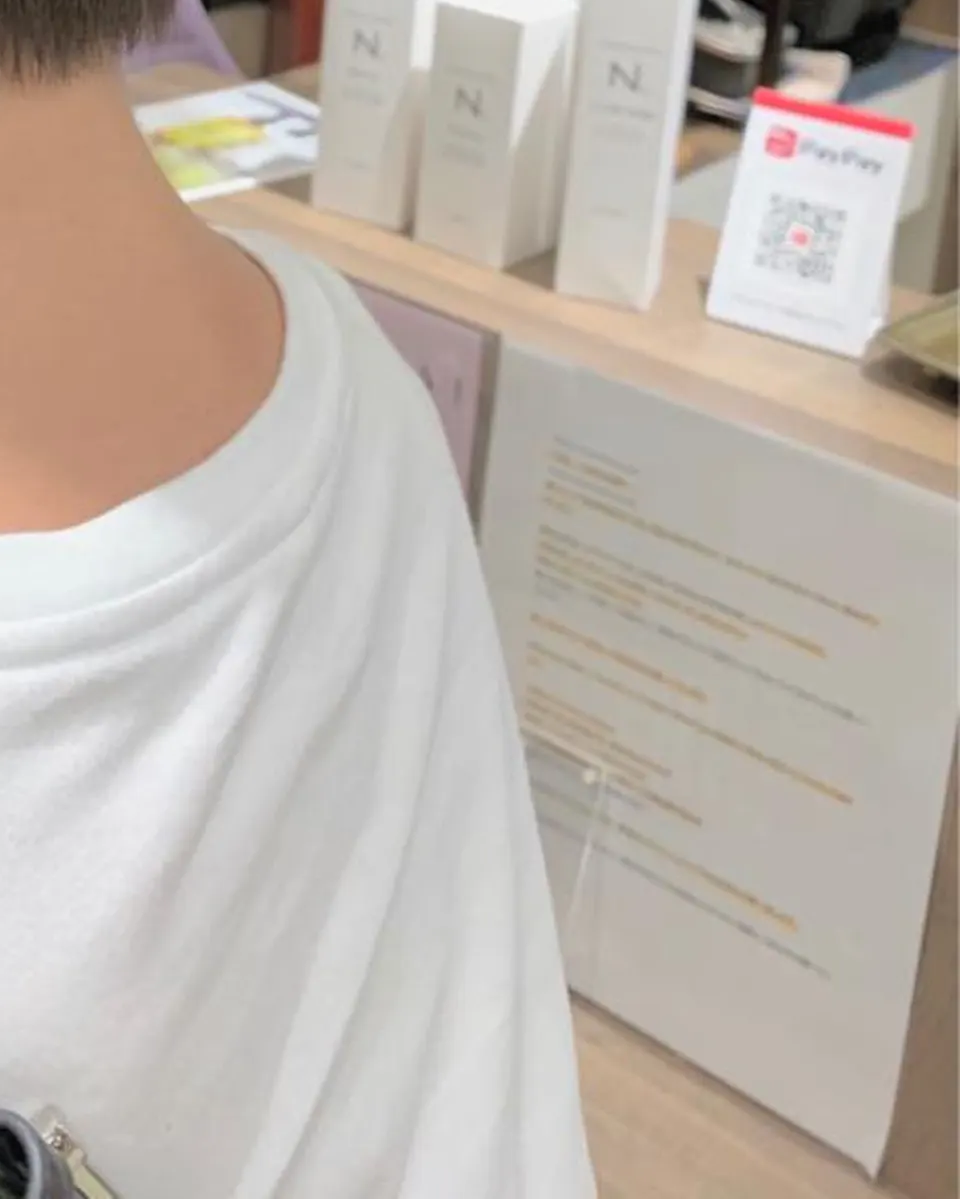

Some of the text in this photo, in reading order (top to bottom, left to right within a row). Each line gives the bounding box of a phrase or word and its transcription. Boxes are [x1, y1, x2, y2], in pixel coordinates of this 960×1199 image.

[351, 28, 381, 59] N
[607, 60, 643, 93] N
[453, 84, 483, 118] N
